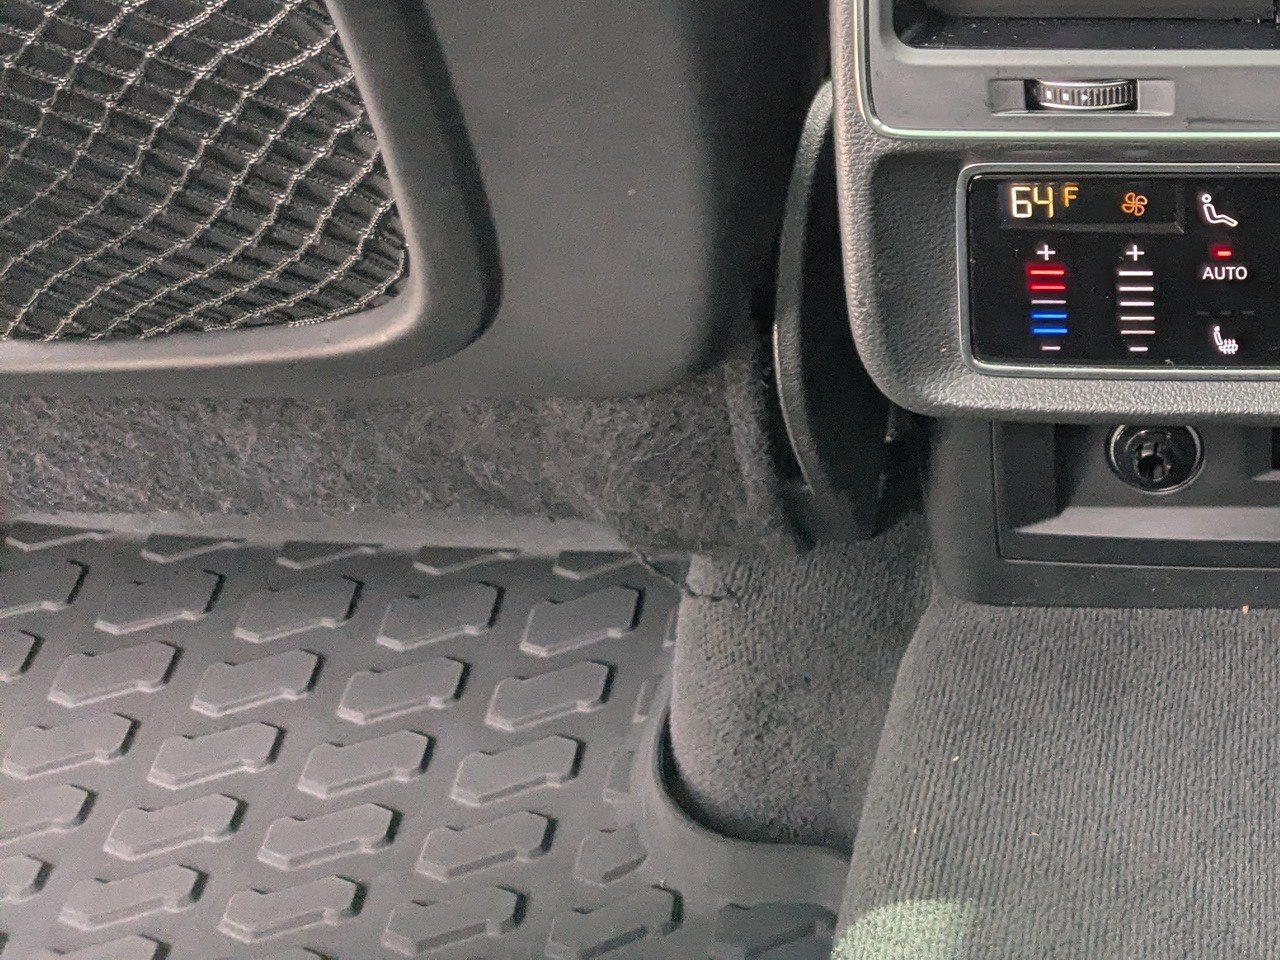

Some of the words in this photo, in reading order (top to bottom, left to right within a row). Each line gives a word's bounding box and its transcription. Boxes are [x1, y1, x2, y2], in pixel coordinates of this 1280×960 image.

[1011, 186, 1054, 218] 64
[1063, 186, 1079, 208] F
[1202, 266, 1248, 280] AUTO
